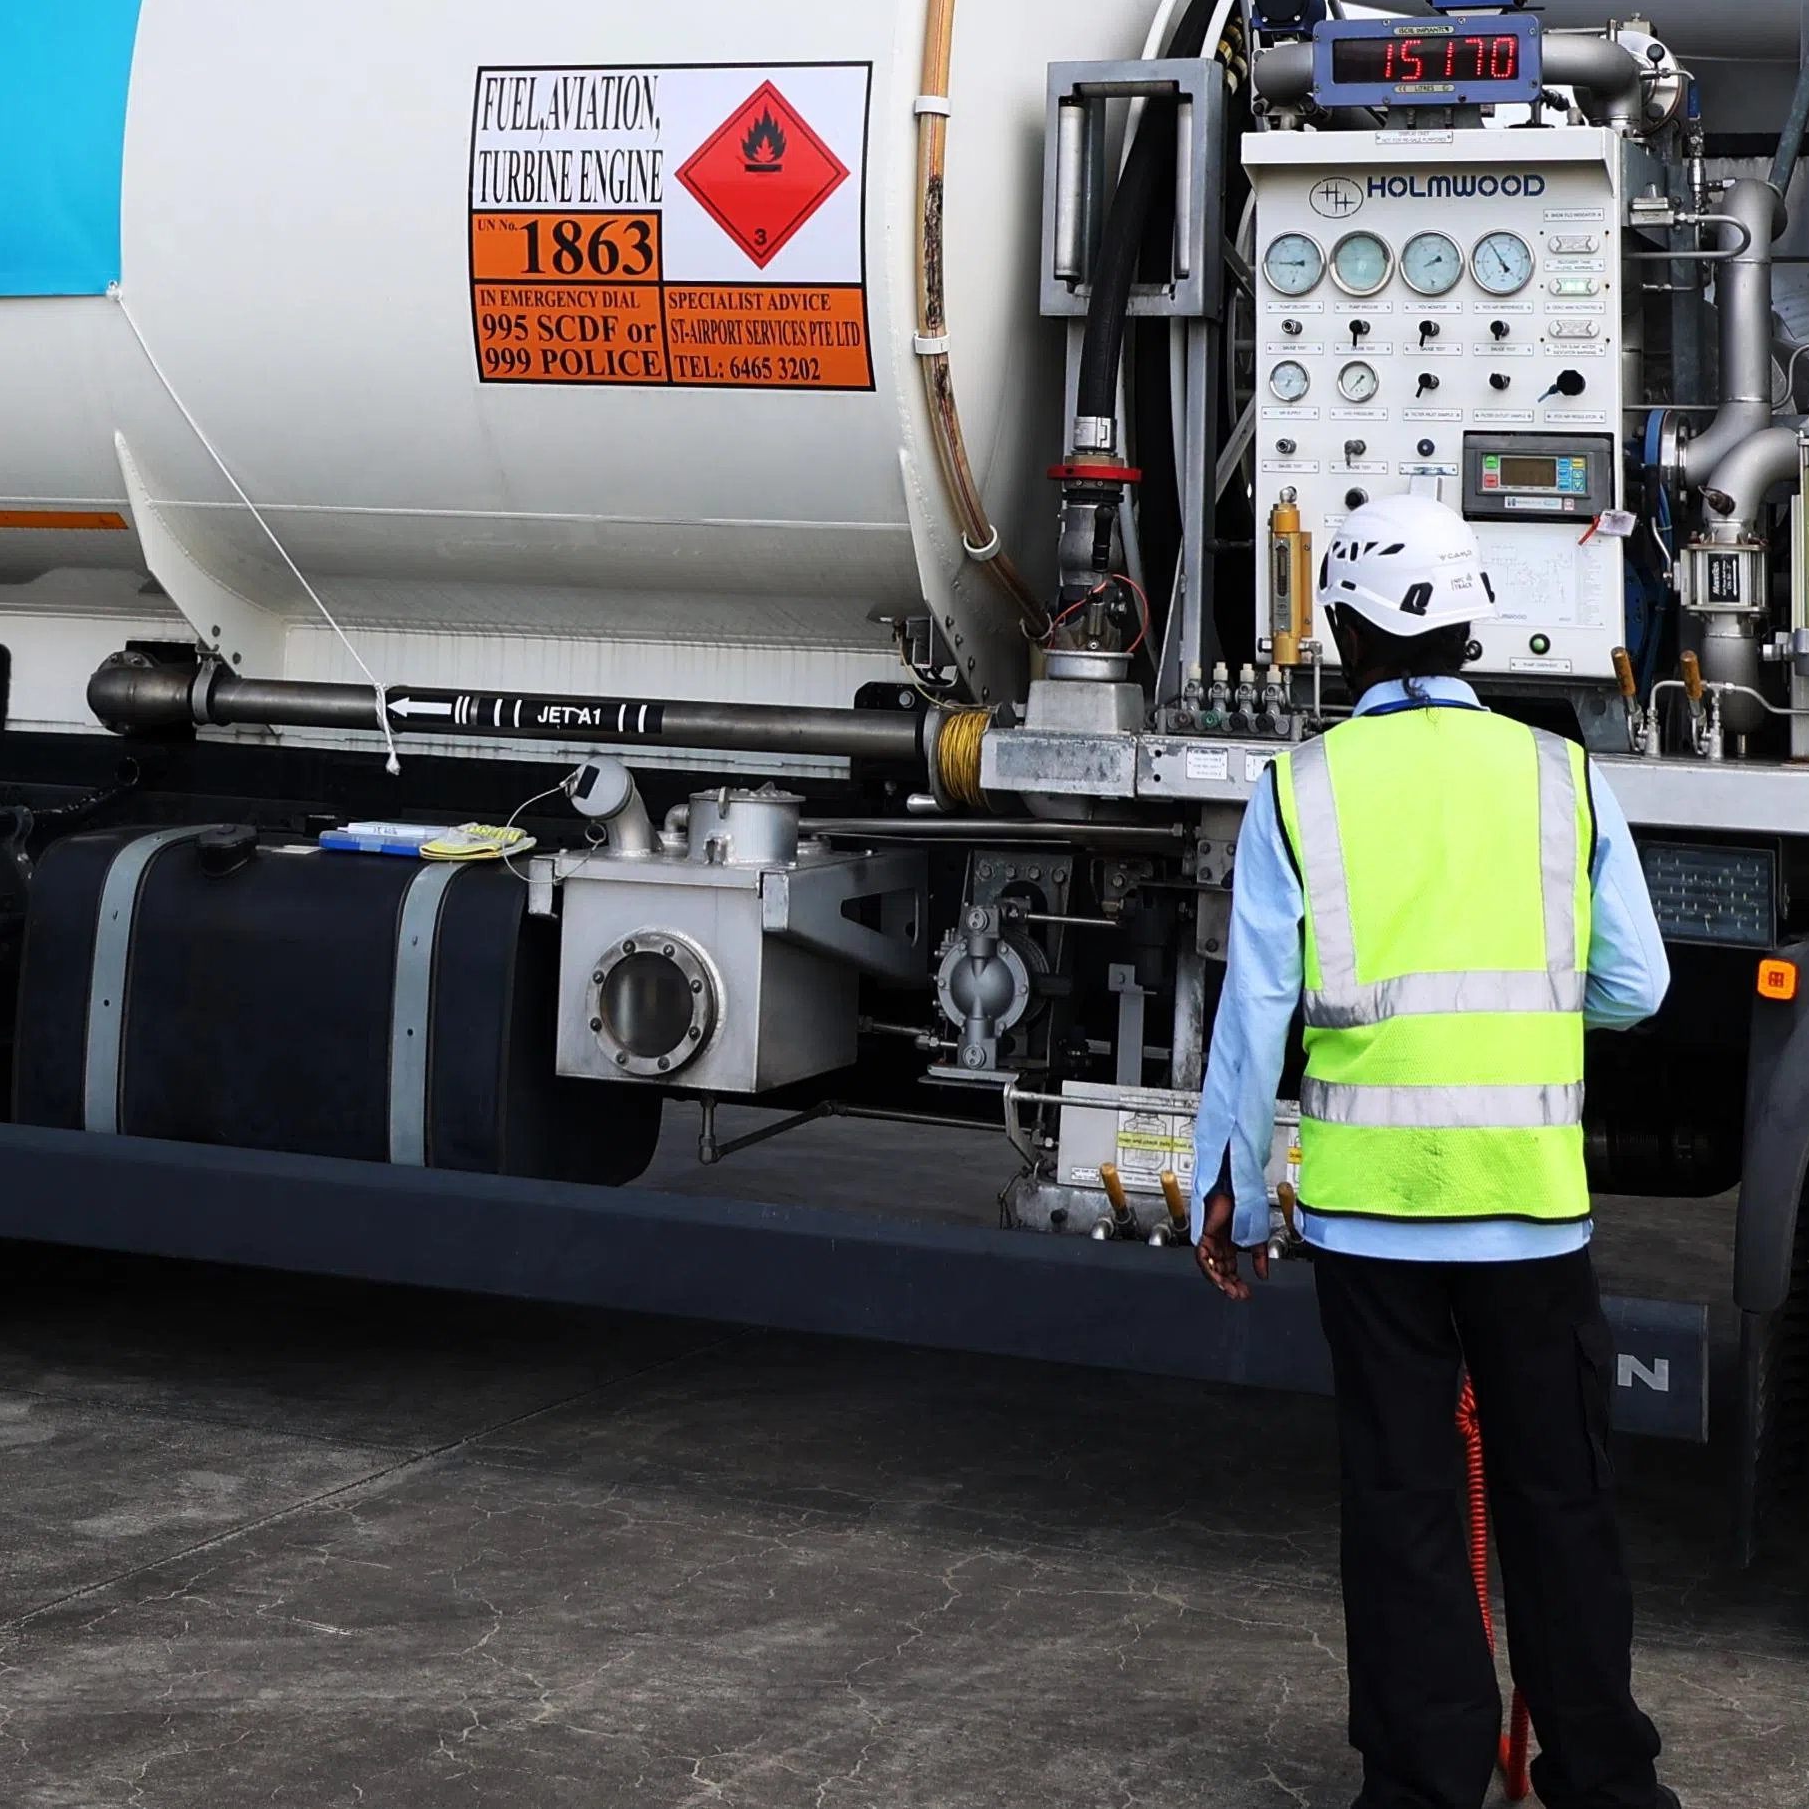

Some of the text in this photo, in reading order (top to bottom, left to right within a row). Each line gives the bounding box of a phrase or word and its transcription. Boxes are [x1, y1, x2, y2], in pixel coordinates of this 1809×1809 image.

[1382, 36, 1518, 81] 15170
[479, 148, 665, 206] TURBINE ENGINE
[1366, 173, 1546, 199] HOLMWOOD
[477, 218, 497, 232] UN
[754, 228, 768, 246] 3
[519, 218, 654, 276] 1863
[480, 289, 640, 308] IN EMERGENCY DIAL
[668, 292, 831, 312] SPECIALIST ADVICE
[482, 314, 657, 344] 995 SCDF or
[670, 317, 862, 348] ST-AIRPORT SERVICES PTE LTD
[485, 348, 663, 378] 999 POLICE
[674, 355, 821, 381] TEL: 6465 3202
[537, 706, 601, 725] JET A1
